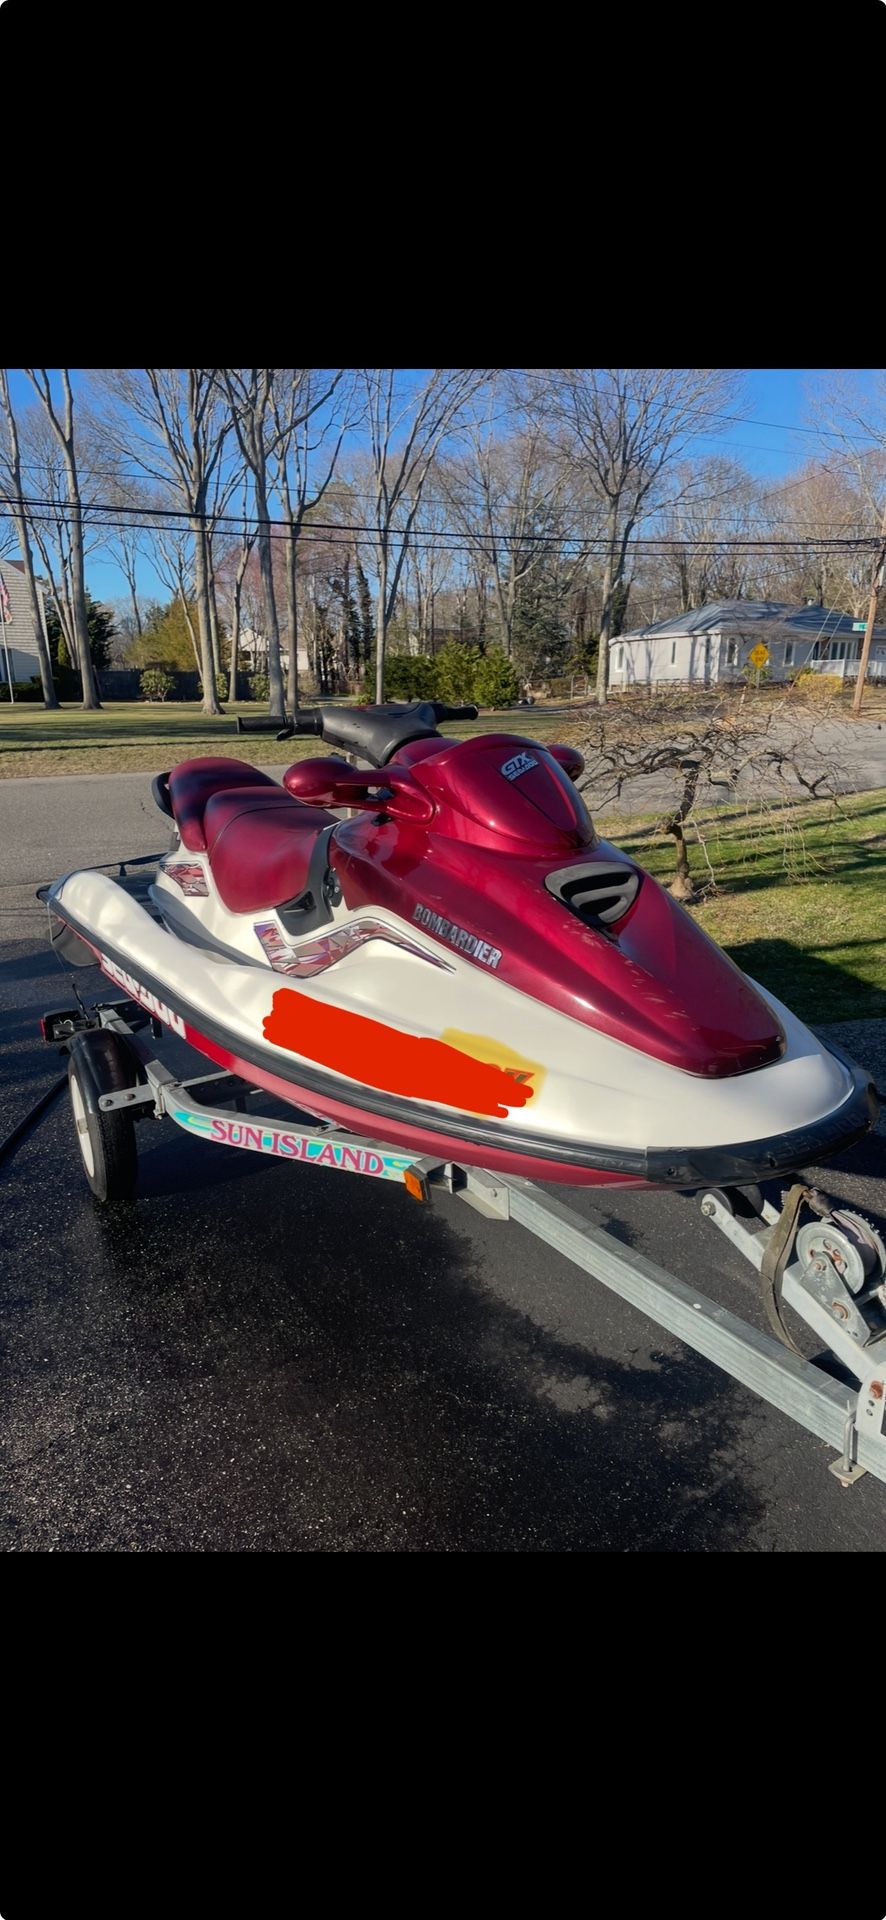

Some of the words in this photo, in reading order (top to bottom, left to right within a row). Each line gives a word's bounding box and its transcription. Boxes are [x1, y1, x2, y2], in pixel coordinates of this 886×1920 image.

[501, 752, 534, 776] GTX
[412, 902, 502, 969] BOMBARDIER
[211, 1120, 264, 1151] SUN
[272, 1132, 384, 1175] ISLAND
